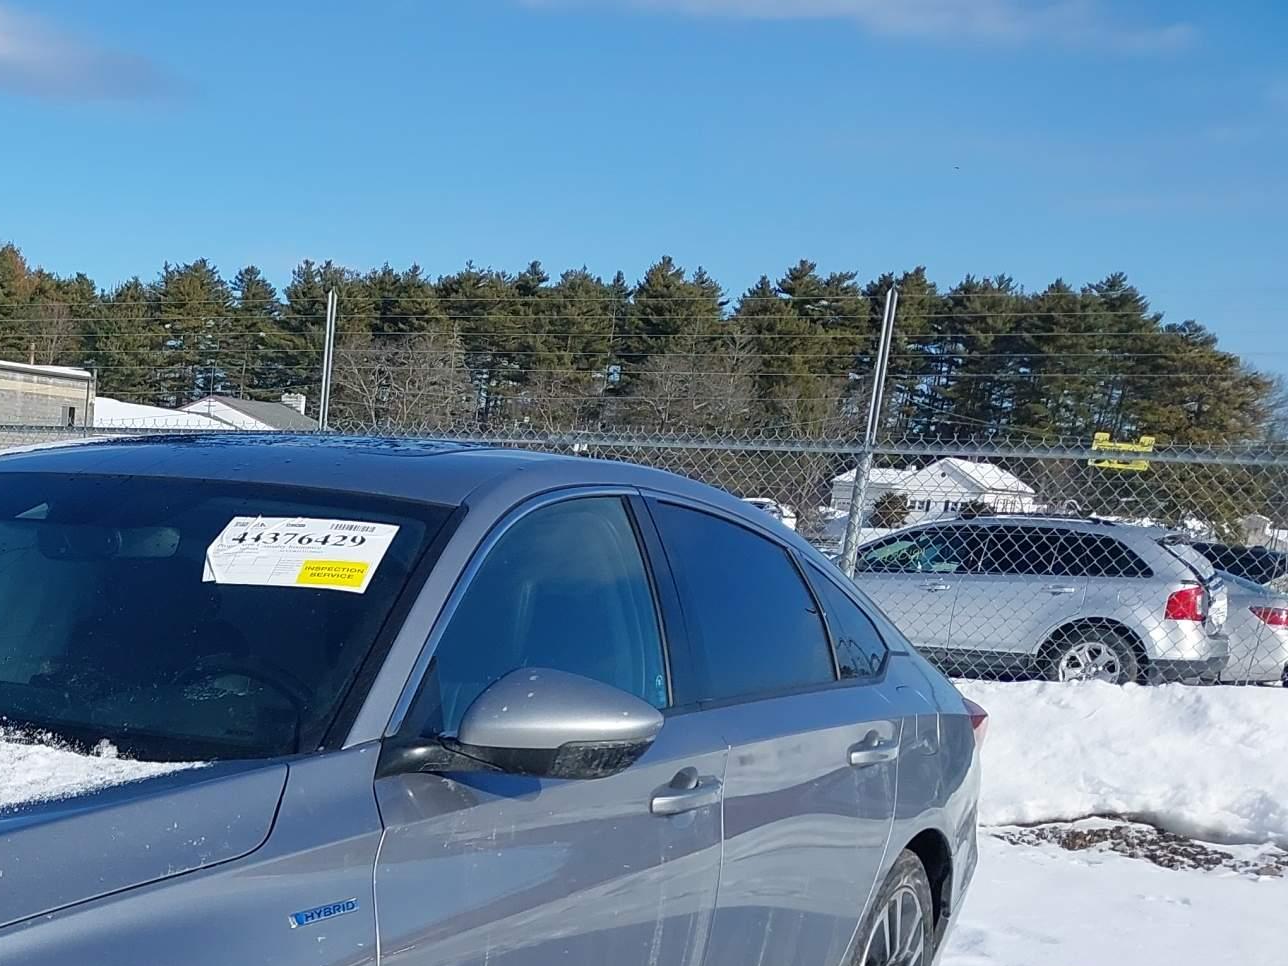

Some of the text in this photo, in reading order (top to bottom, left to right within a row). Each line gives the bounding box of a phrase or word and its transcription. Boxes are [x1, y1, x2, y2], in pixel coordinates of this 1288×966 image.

[232, 531, 366, 548] 44376429
[304, 565, 365, 574] INSPECTION
[309, 571, 355, 580] SERVICE
[304, 900, 356, 922] HYBRID
